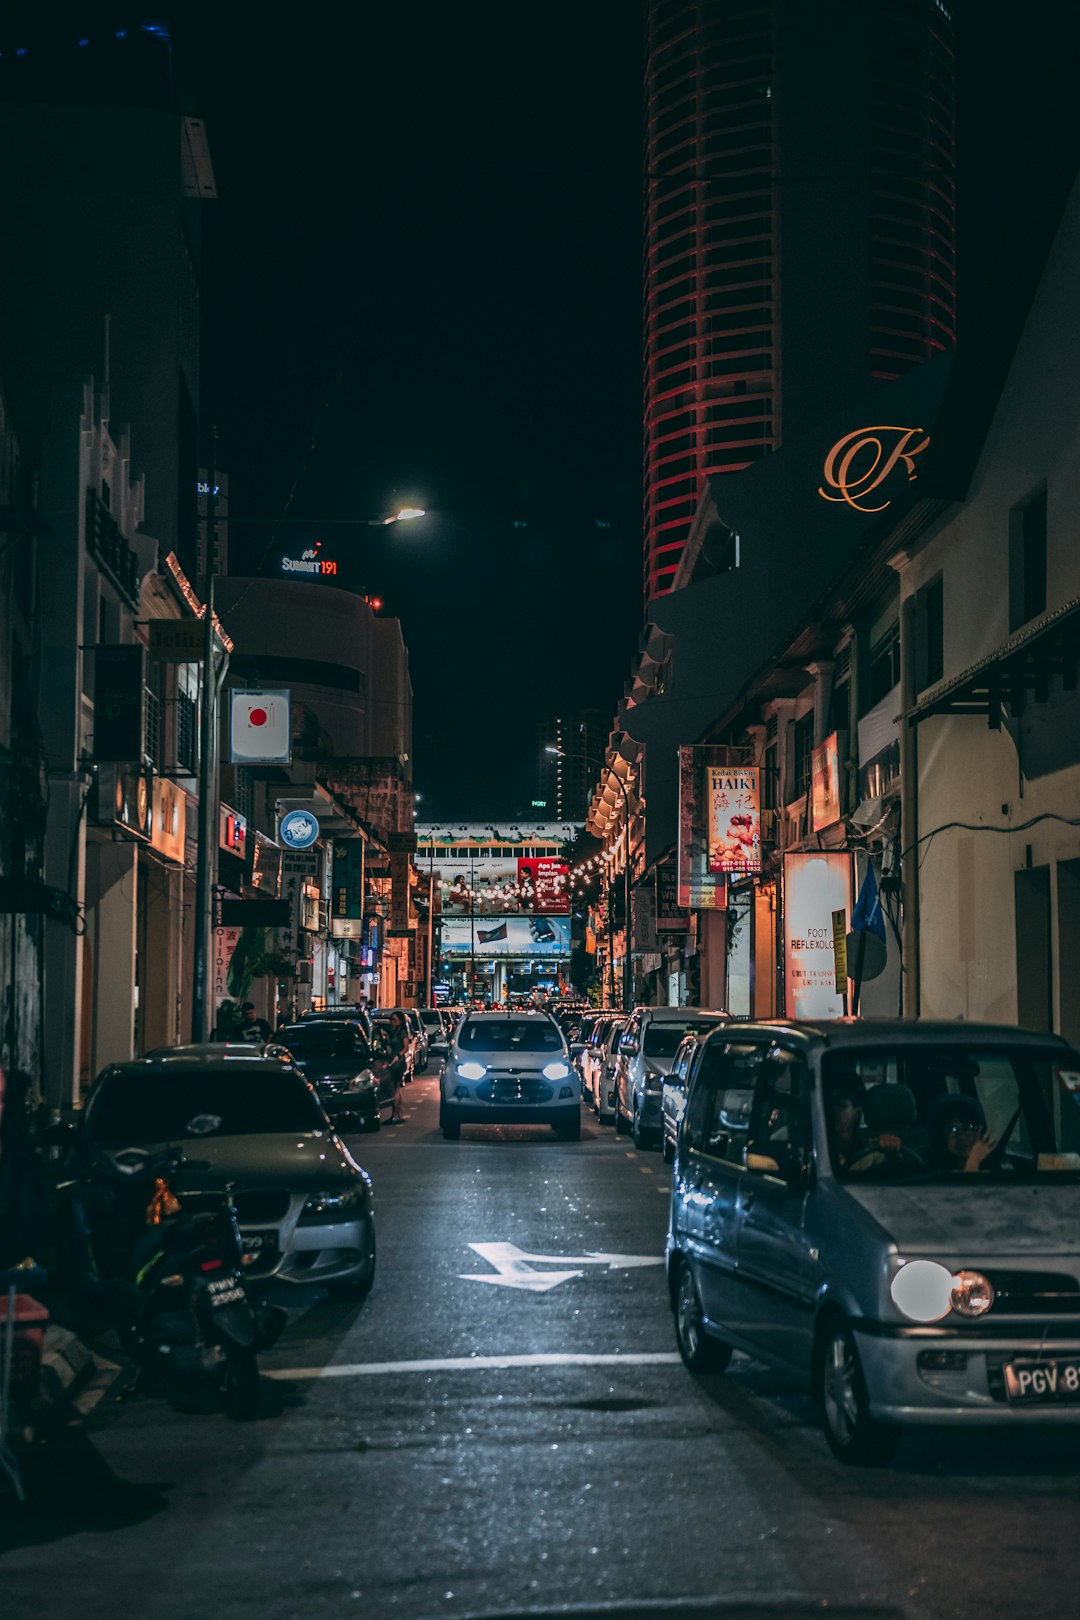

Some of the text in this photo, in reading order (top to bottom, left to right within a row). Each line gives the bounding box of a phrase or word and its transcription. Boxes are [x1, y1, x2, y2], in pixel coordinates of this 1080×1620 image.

[712, 778, 756, 790] HAIKI
[807, 928, 828, 938] FOOT
[791, 940, 835, 950] REFLEXOLO
[1019, 1365, 1080, 1396] PGV 8
